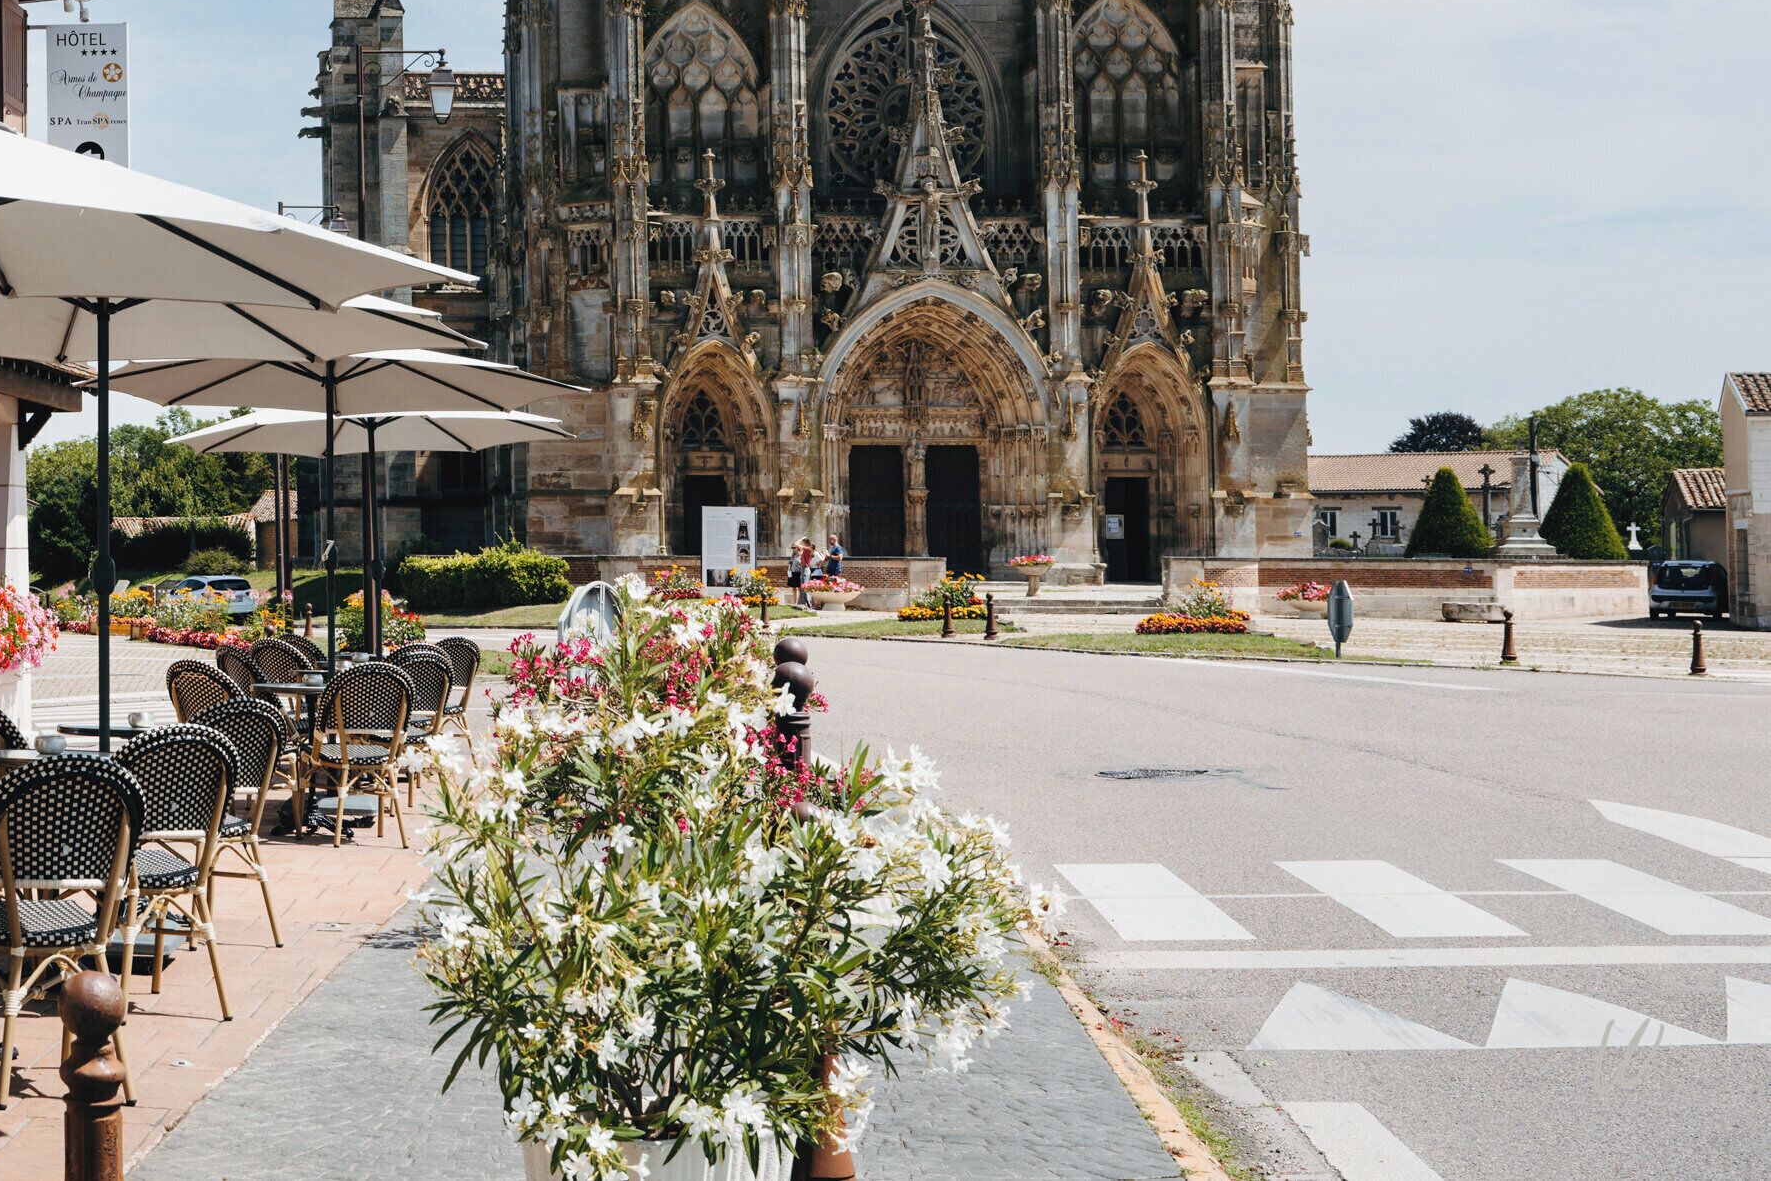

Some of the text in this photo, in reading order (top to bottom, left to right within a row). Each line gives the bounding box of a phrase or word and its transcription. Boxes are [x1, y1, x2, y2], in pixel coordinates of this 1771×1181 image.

[56, 30, 106, 46] HÔTEL
[50, 69, 98, 85] Armes de
[73, 84, 127, 102] Champagne
[50, 117, 72, 125] SPA
